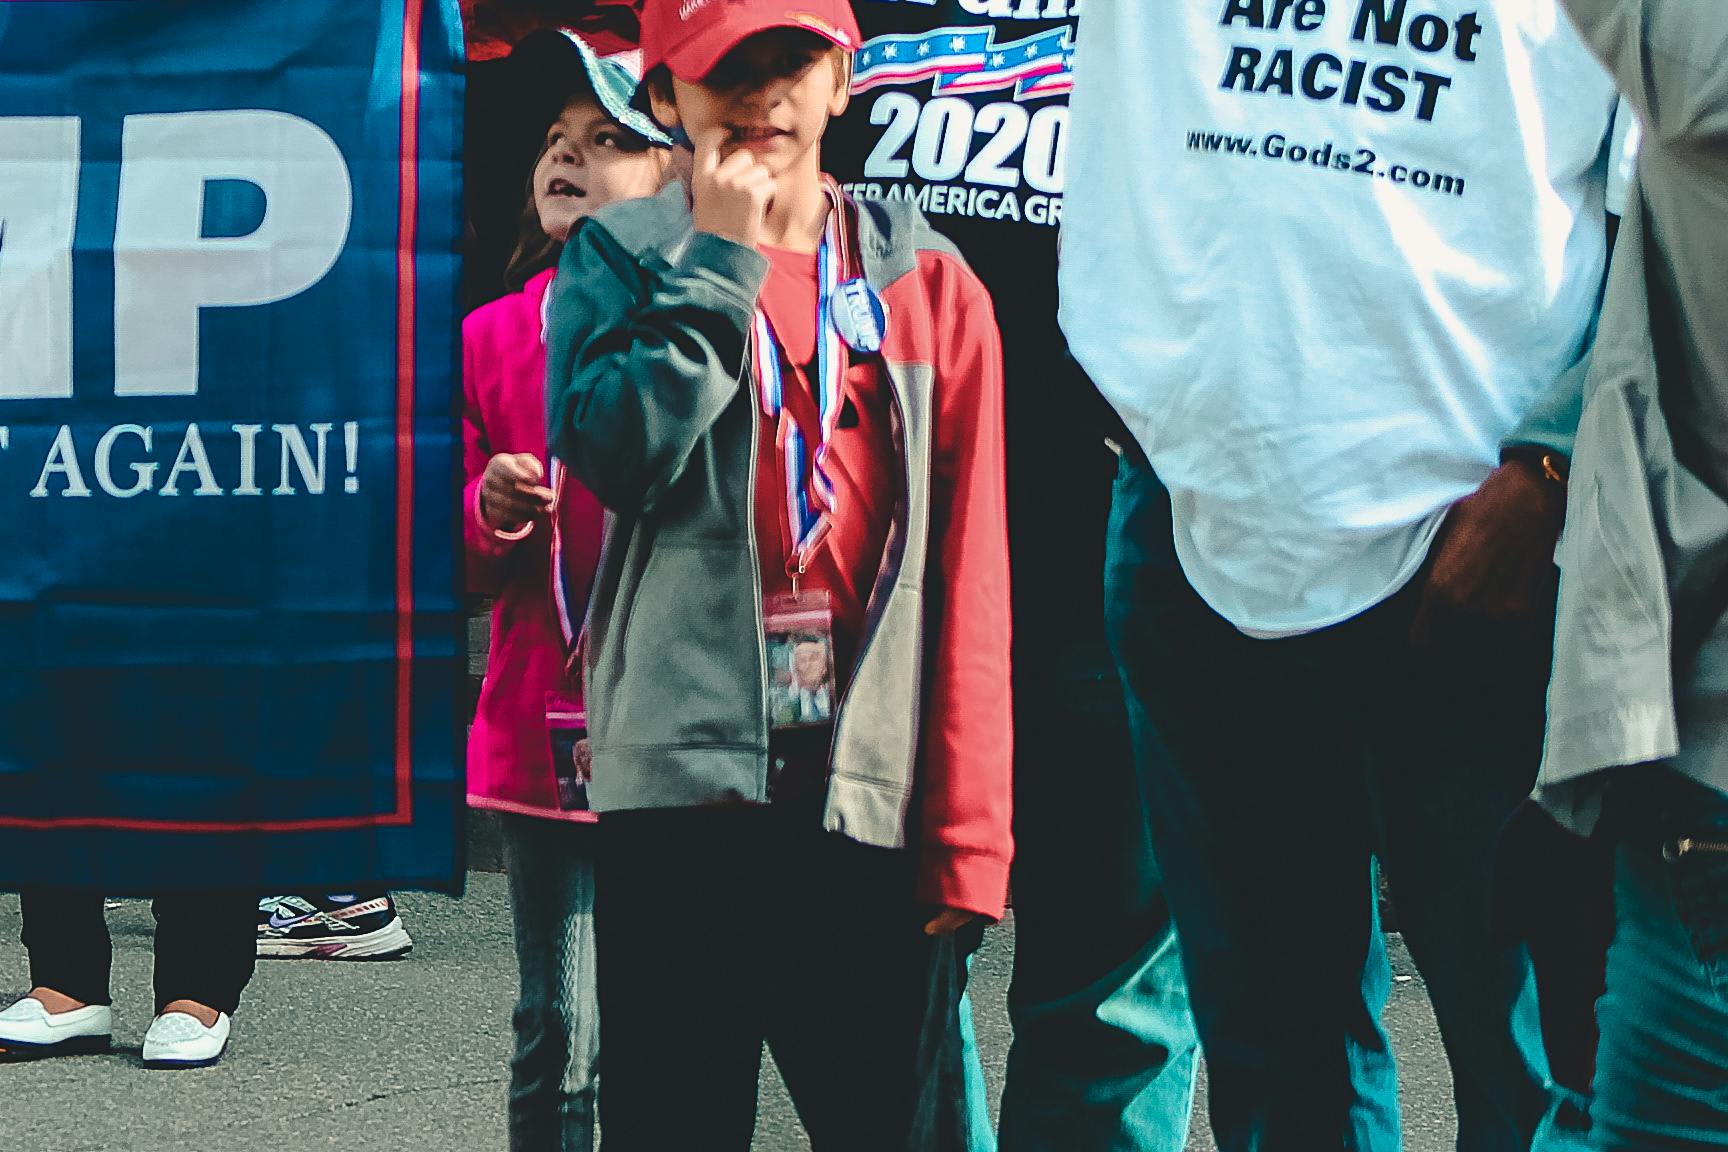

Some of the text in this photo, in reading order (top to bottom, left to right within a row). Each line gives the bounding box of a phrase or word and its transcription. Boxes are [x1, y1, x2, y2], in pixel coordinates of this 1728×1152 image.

[1219, 44, 1452, 122] RACIST
[864, 91, 1070, 194] 2020
[1185, 129, 1466, 196] www.Gods2.com
[885, 183, 1021, 222] AMERICA
[846, 278, 881, 352] TRUMP
[30, 420, 360, 498] AGAIN!
